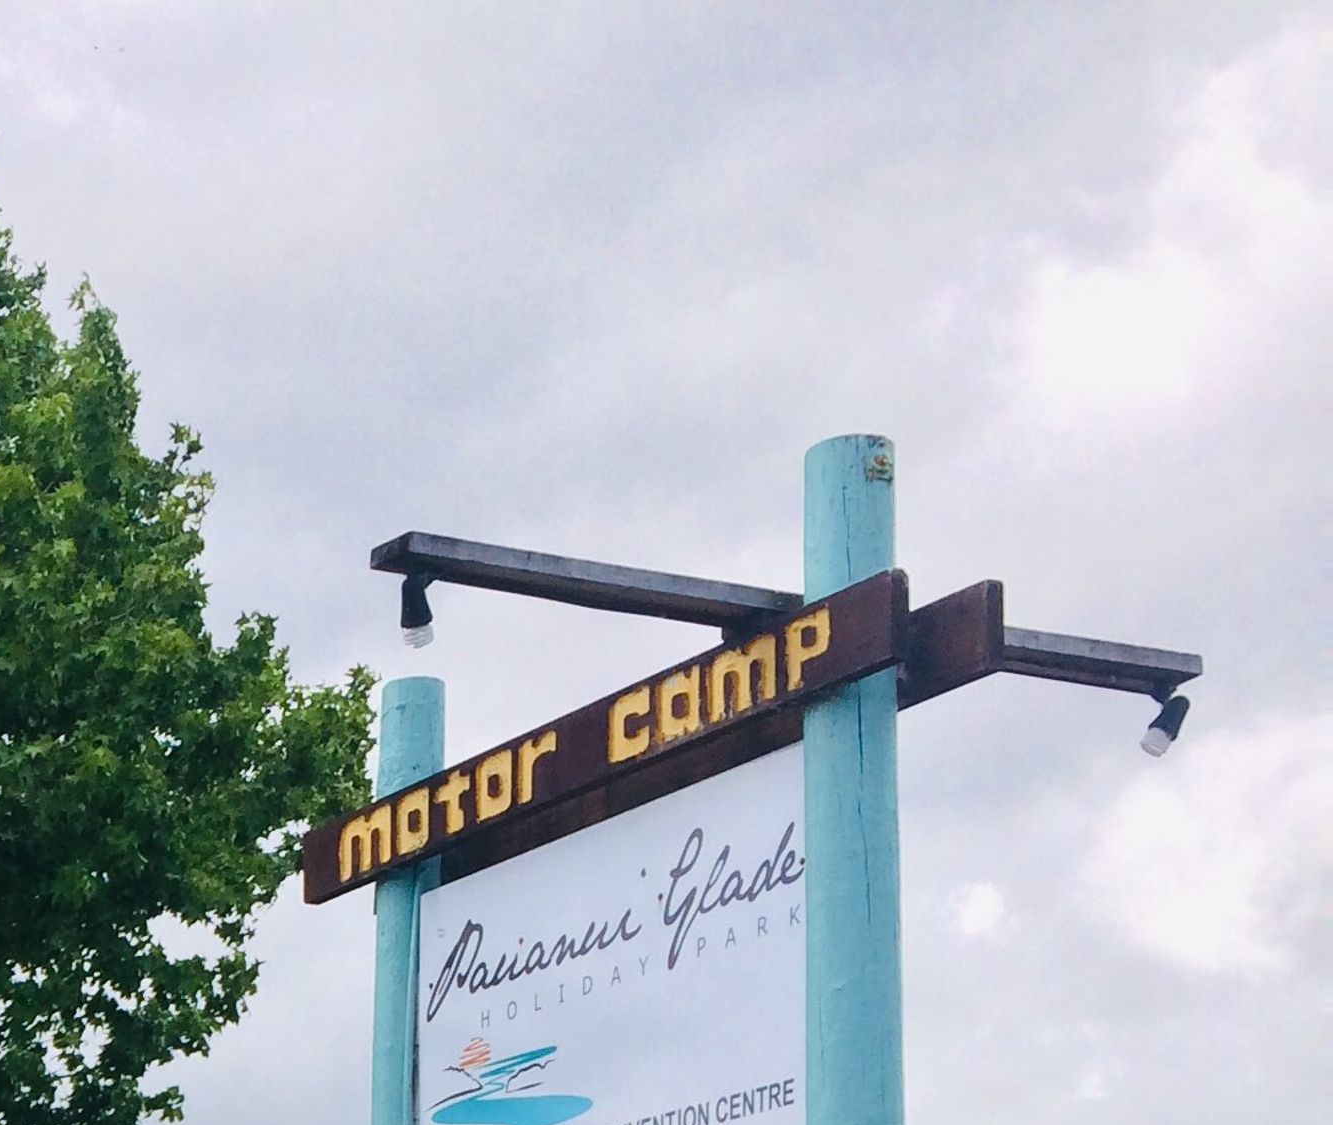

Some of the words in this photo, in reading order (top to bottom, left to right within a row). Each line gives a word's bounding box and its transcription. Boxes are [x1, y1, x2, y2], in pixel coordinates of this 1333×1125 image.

[338, 731, 557, 883] motor
[607, 603, 830, 764] camp
[664, 822, 804, 971] Glade
[480, 956, 649, 1029] HOLIDAY
[696, 904, 802, 958] PARK
[715, 1078, 795, 1123] CENTRE
